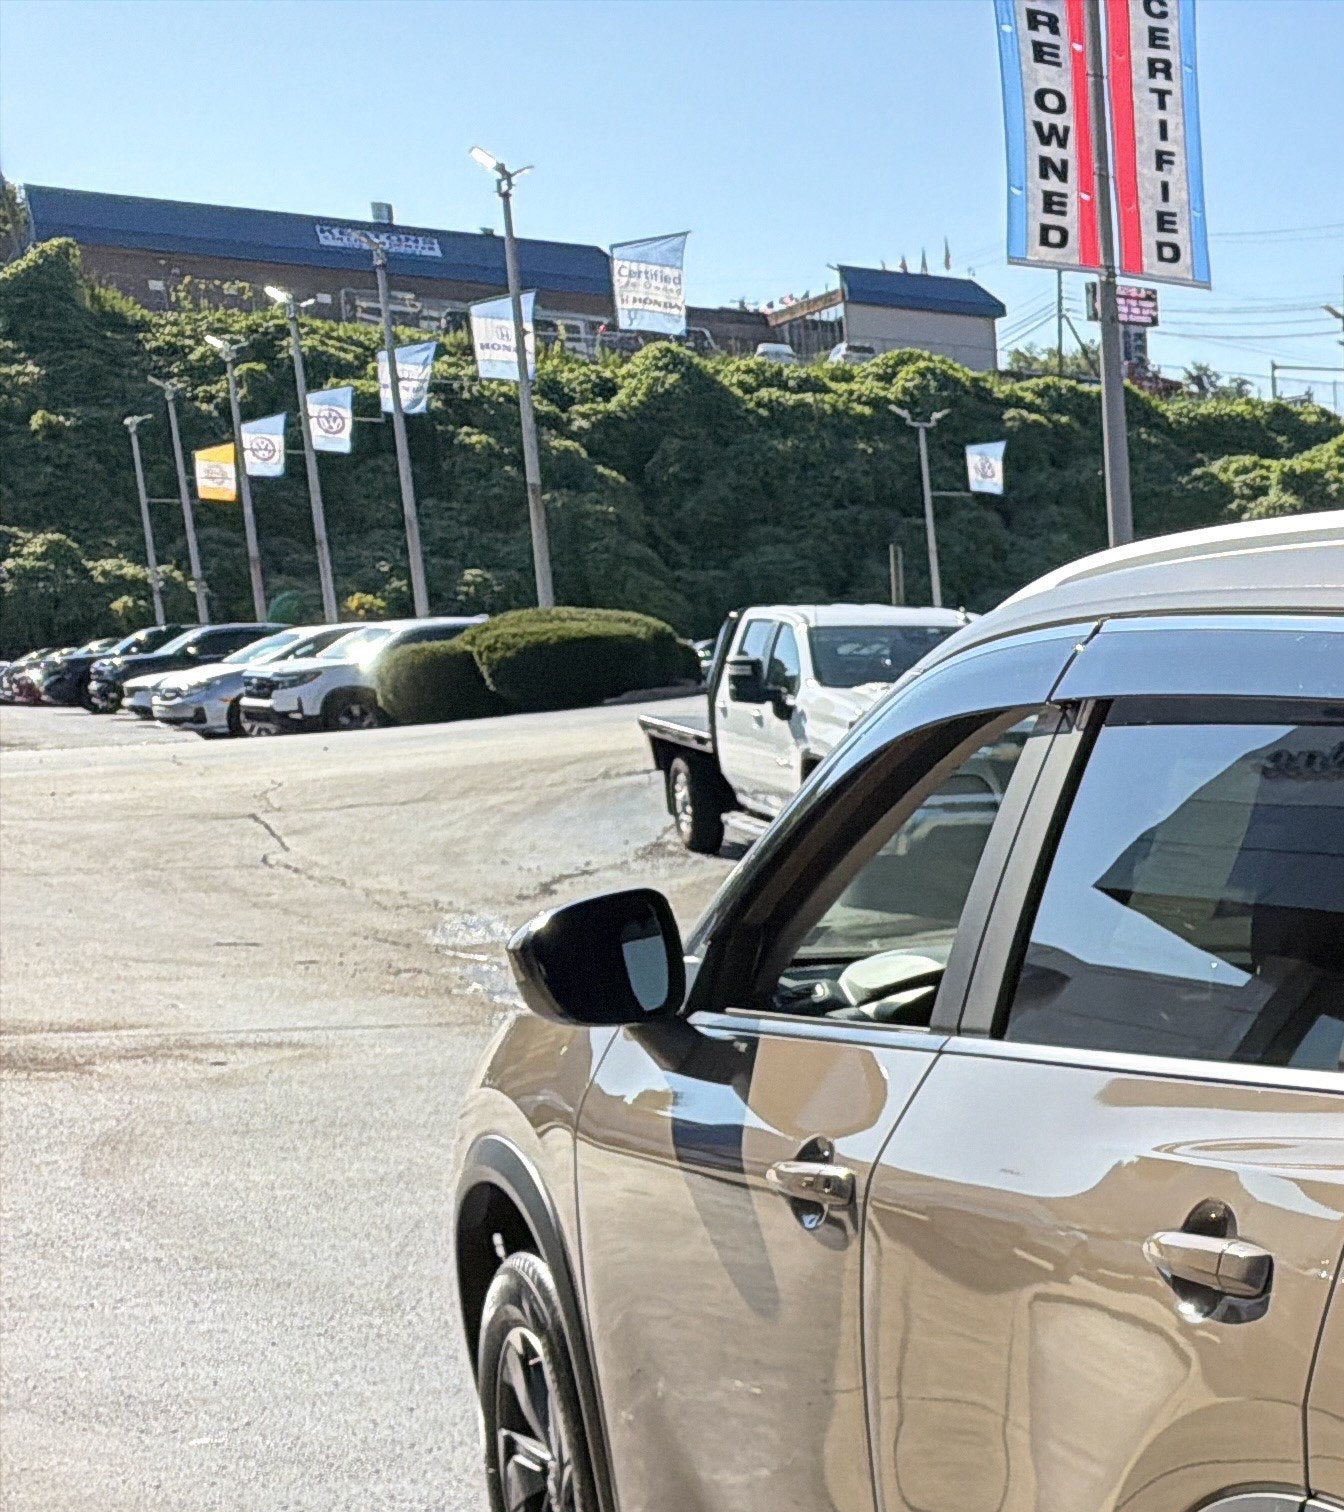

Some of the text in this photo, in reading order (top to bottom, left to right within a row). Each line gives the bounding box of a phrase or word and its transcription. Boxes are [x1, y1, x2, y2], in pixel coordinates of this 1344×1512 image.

[1032, 87, 1070, 250] OWNED
[1143, 0, 1181, 264] CERTIFIED
[617, 264, 682, 286] Certified
